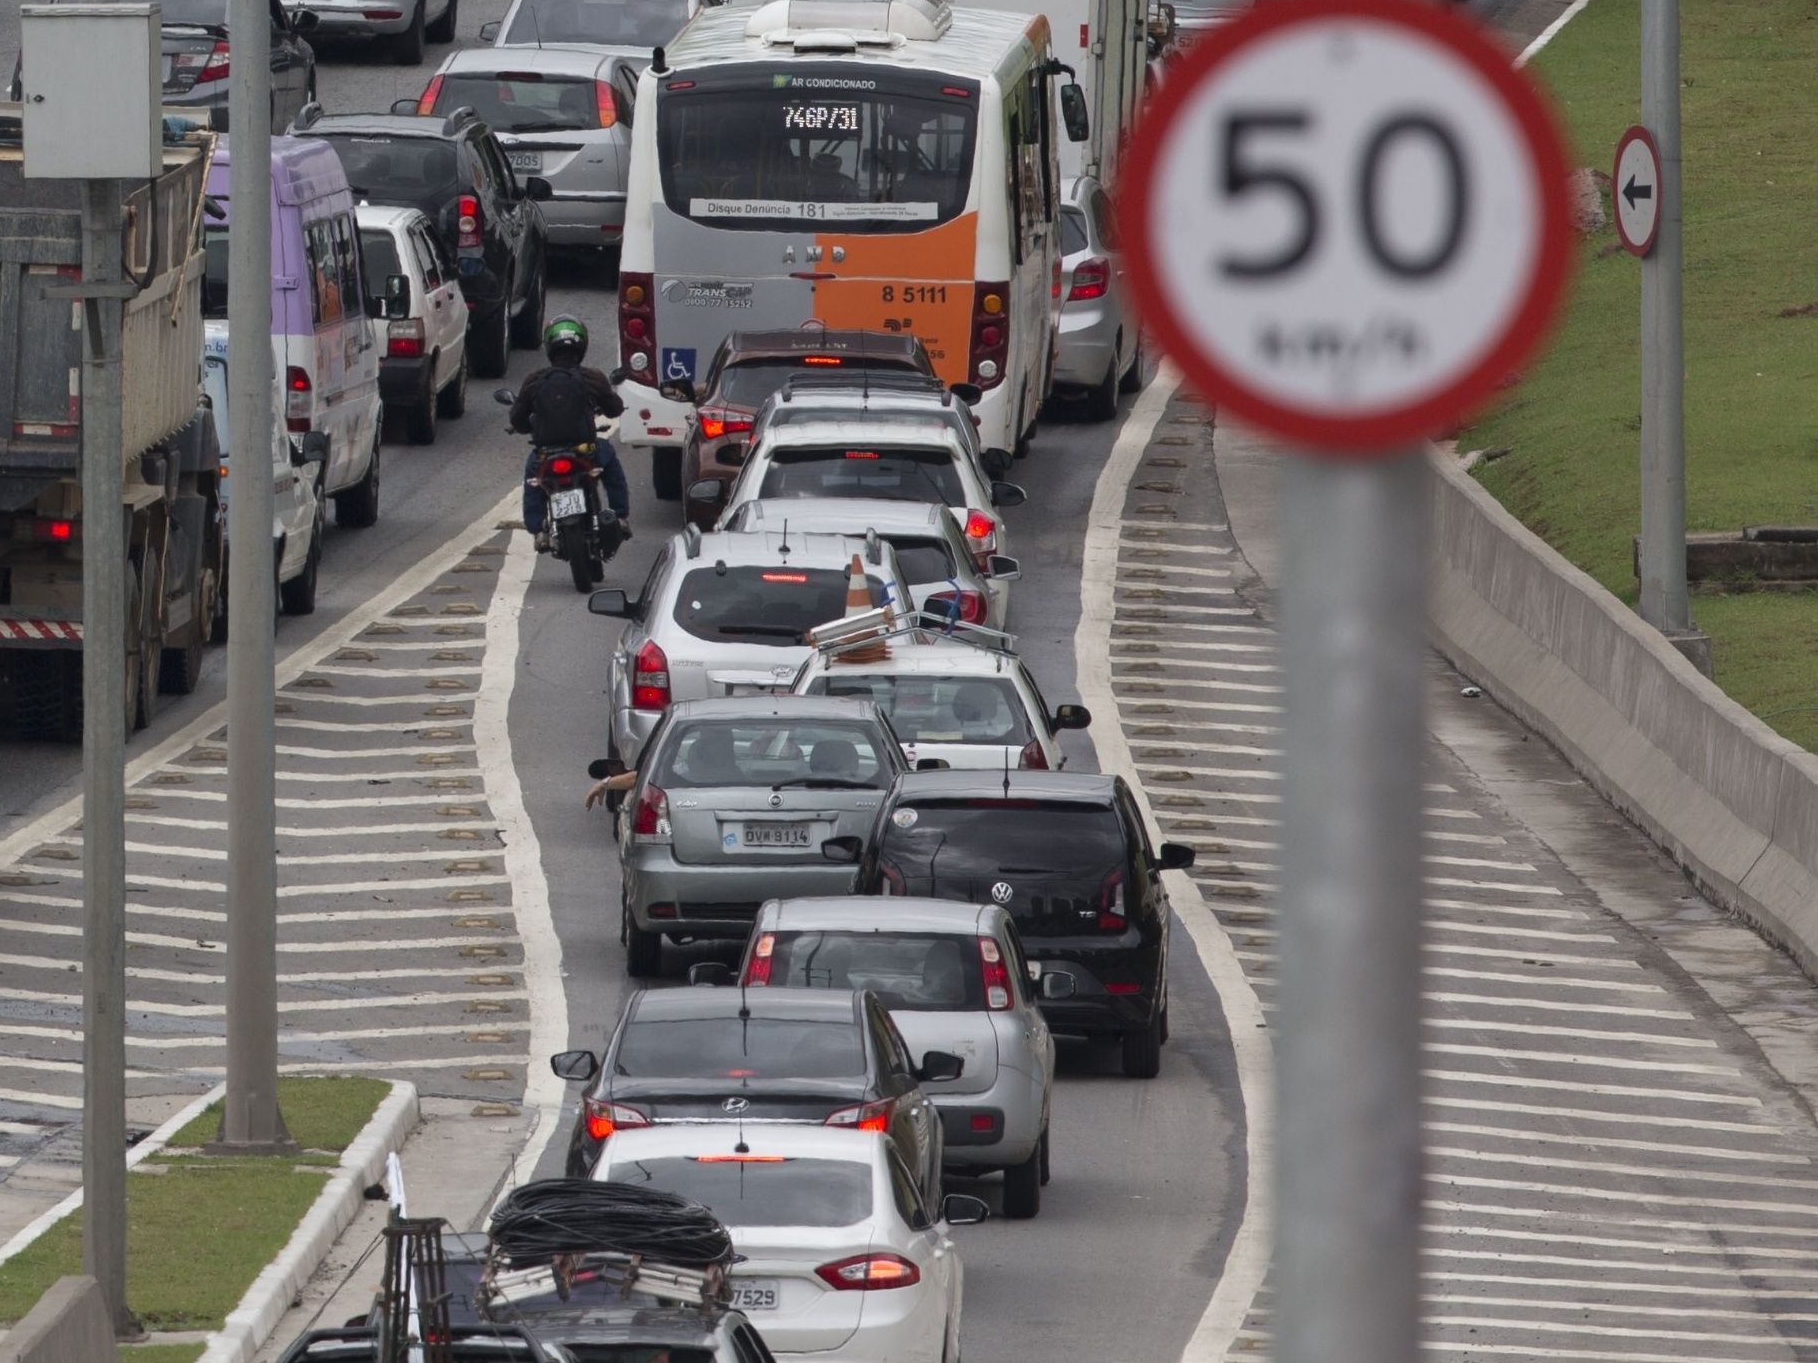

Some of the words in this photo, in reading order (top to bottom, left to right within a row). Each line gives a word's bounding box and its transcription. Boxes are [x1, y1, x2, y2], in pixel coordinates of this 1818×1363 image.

[791, 77, 804, 87] AR
[805, 78, 876, 90] CONDICIONADO
[1217, 104, 1472, 284] 50
[707, 202, 743, 215] Disque
[745, 203, 792, 215] Denúncia
[798, 203, 826, 219] 181
[882, 285, 895, 303] 8
[902, 285, 947, 304] 5111
